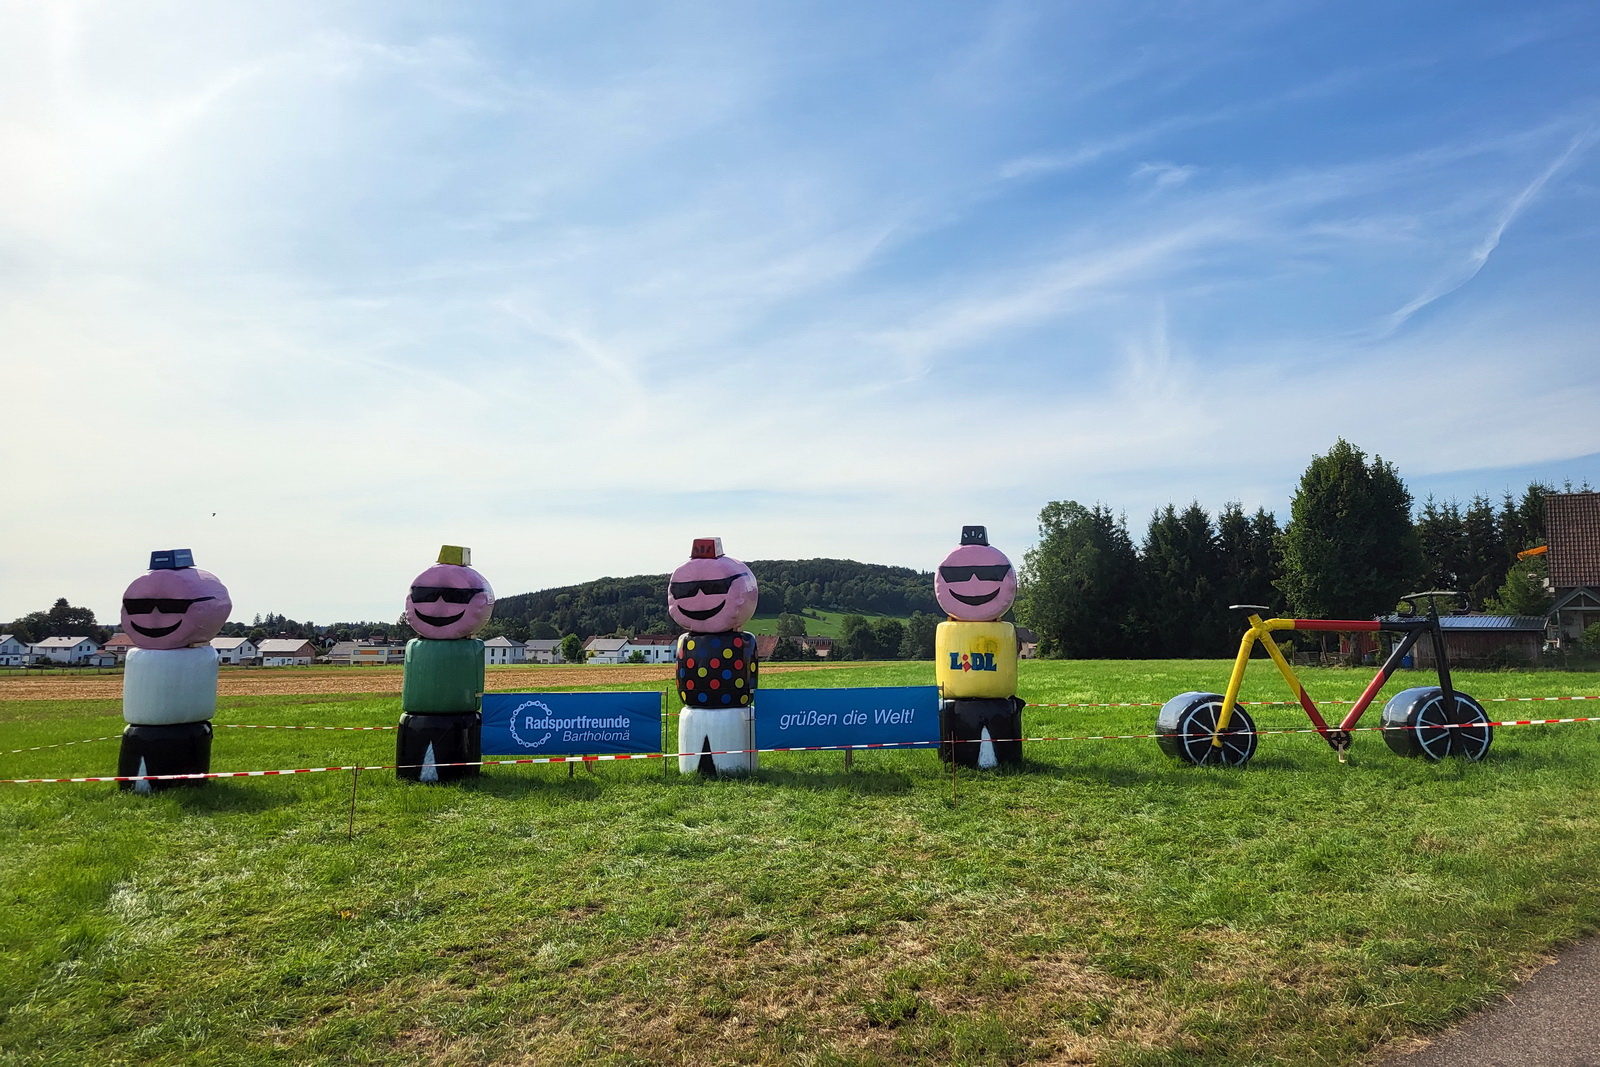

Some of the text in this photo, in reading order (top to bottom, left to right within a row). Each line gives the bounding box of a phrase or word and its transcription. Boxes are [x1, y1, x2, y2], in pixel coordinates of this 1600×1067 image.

[525, 715, 630, 732] Radsportfreunde
[780, 708, 915, 730] grüßen die Welt!
[563, 730, 630, 742] Bartholomä
